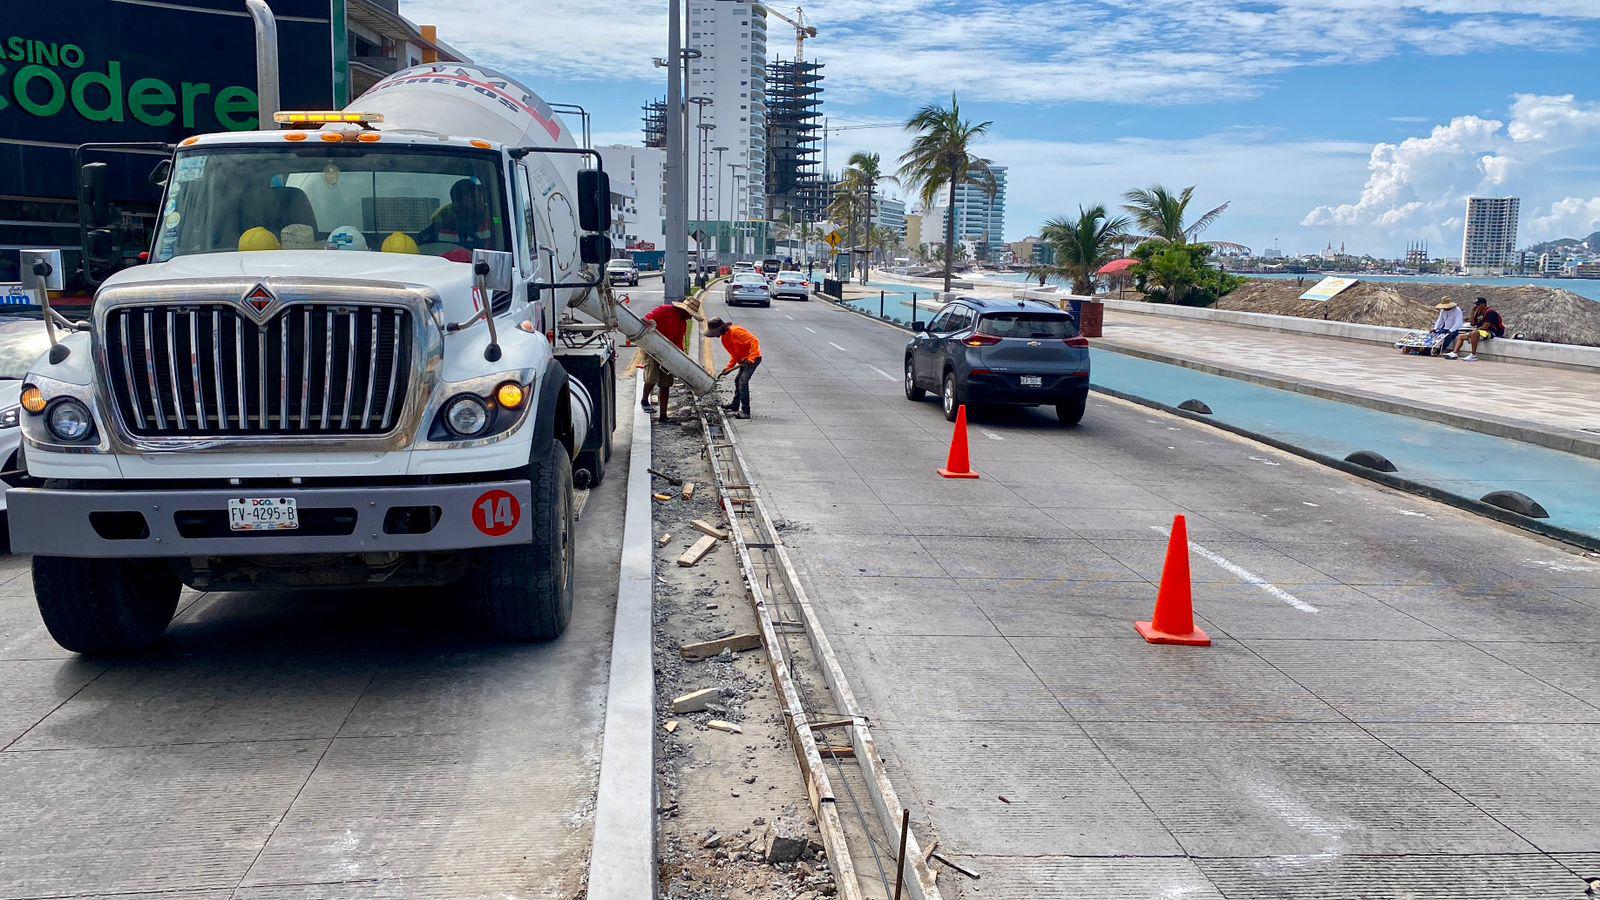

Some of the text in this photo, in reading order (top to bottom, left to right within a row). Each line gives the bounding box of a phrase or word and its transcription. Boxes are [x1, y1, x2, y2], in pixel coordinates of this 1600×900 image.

[0, 60, 259, 132] odere
[231, 506, 295, 521] FV-4295-B
[478, 496, 514, 529] 14
